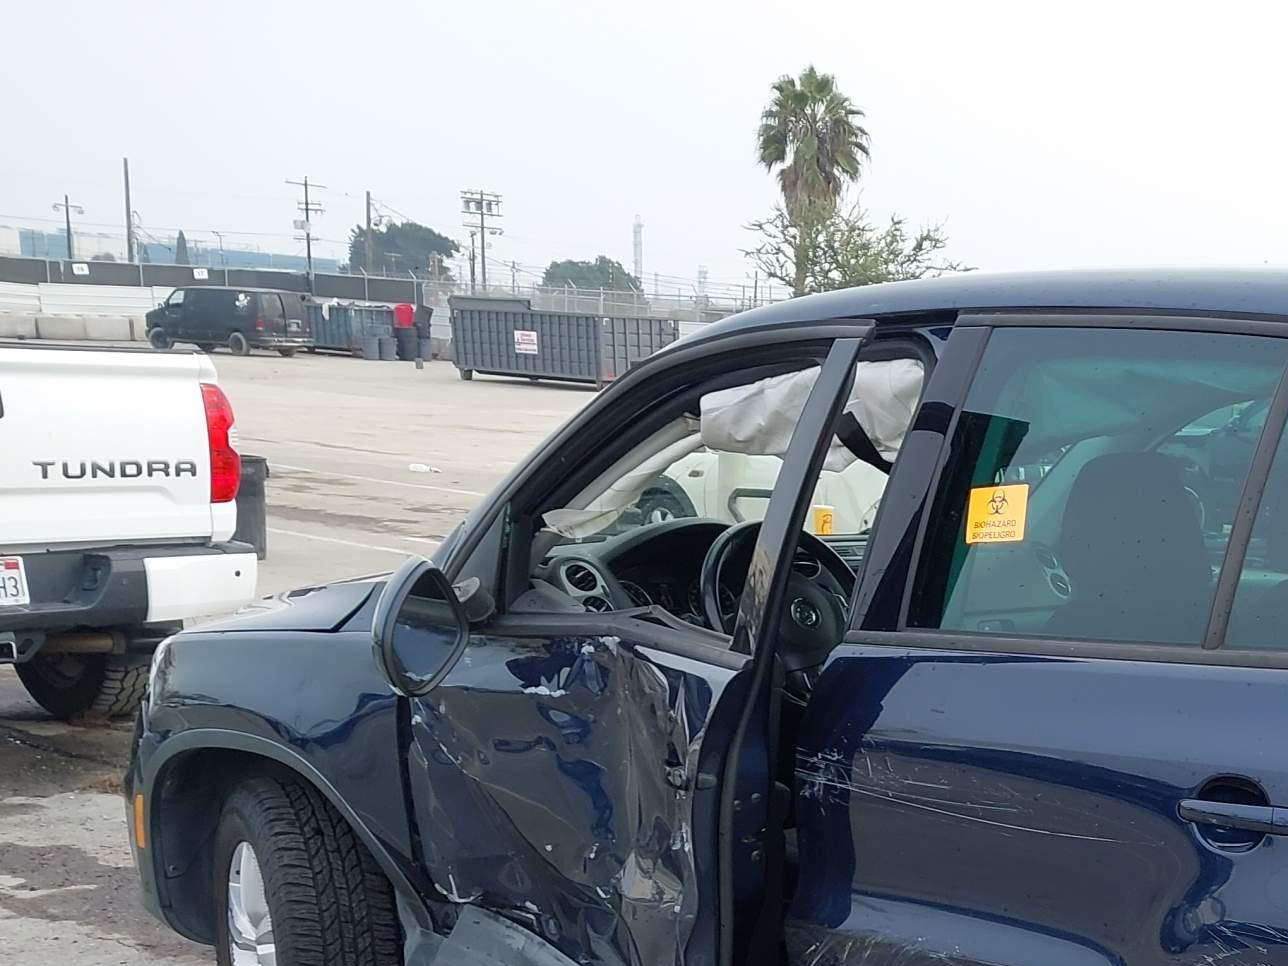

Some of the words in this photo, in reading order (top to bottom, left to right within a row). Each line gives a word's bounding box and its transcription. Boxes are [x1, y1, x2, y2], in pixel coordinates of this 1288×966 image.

[32, 461, 198, 479] TUNDRA
[974, 519, 1017, 529] BIOHAZARD
[971, 530, 1016, 540] BIOPELIGRO
